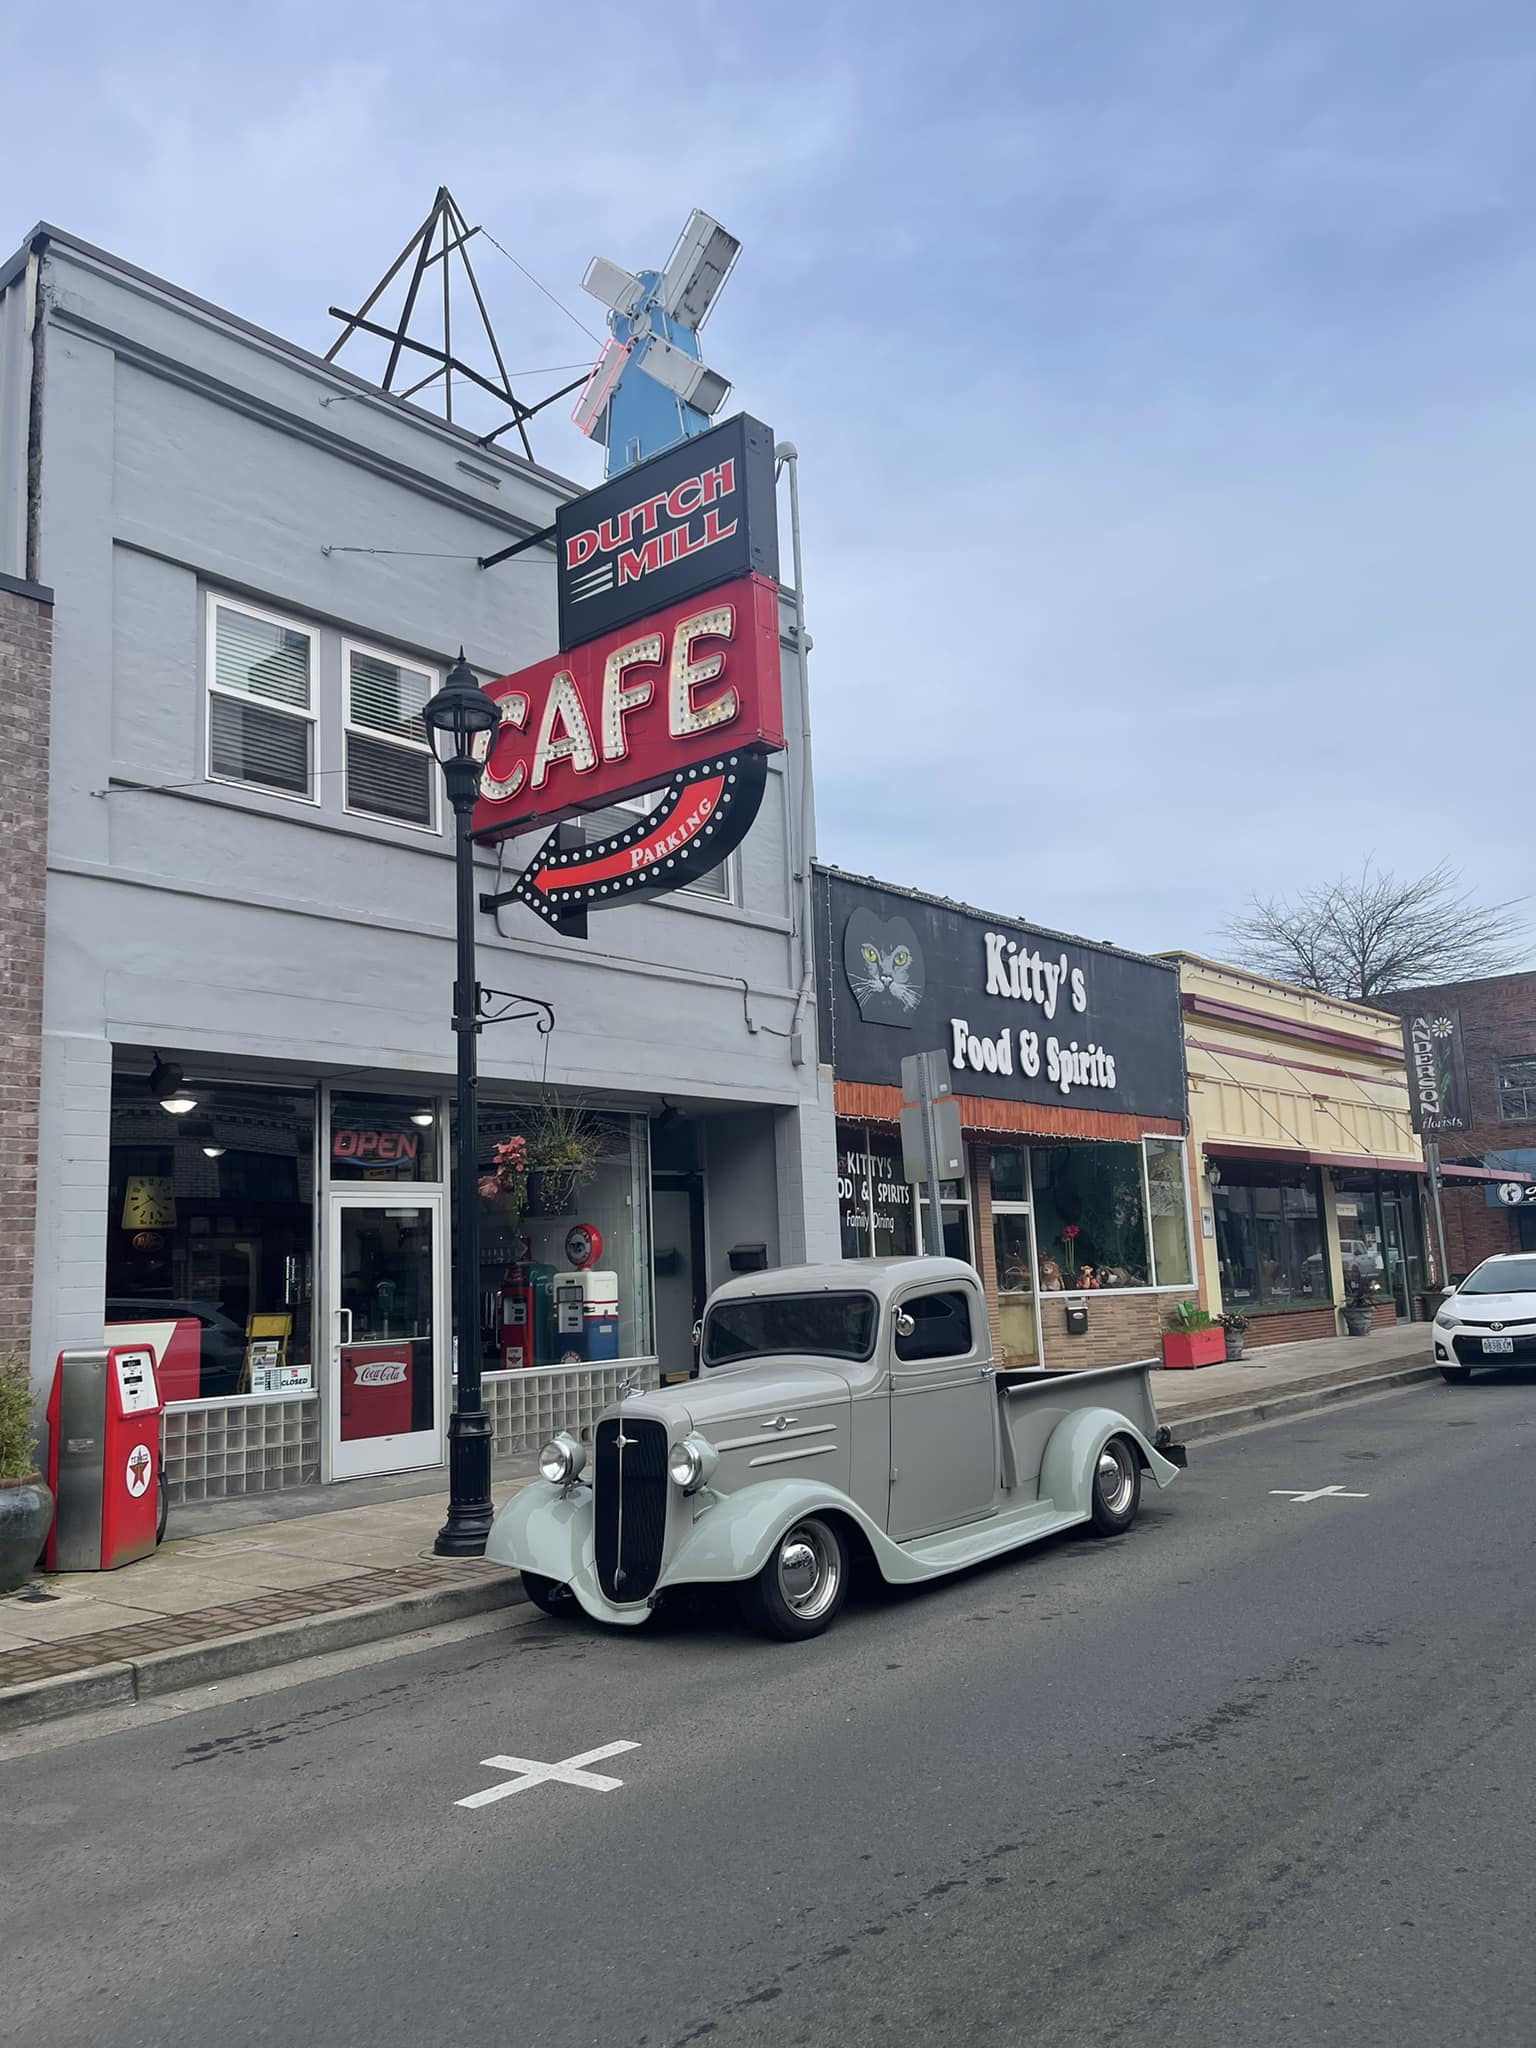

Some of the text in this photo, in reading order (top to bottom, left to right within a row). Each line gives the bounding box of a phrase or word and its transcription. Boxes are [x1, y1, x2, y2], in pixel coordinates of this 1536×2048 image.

[566, 457, 736, 571] DUTCH
[617, 508, 739, 587] MILL
[471, 603, 740, 804] CAFE
[630, 798, 712, 869] PARKING
[984, 932, 1087, 1020] Kitty's
[951, 1018, 1117, 1094] Food & Spirits
[1411, 1017, 1440, 1115] ANDERSON
[334, 1130, 418, 1159] OPEN
[1422, 1115, 1464, 1130] florists
[847, 1151, 892, 1179] KITTY'S
[861, 1181, 870, 1201] &
[878, 1182, 910, 1205] SPIRITS
[846, 1209, 895, 1234] Family Dining
[281, 1377, 308, 1387] CLOSED
